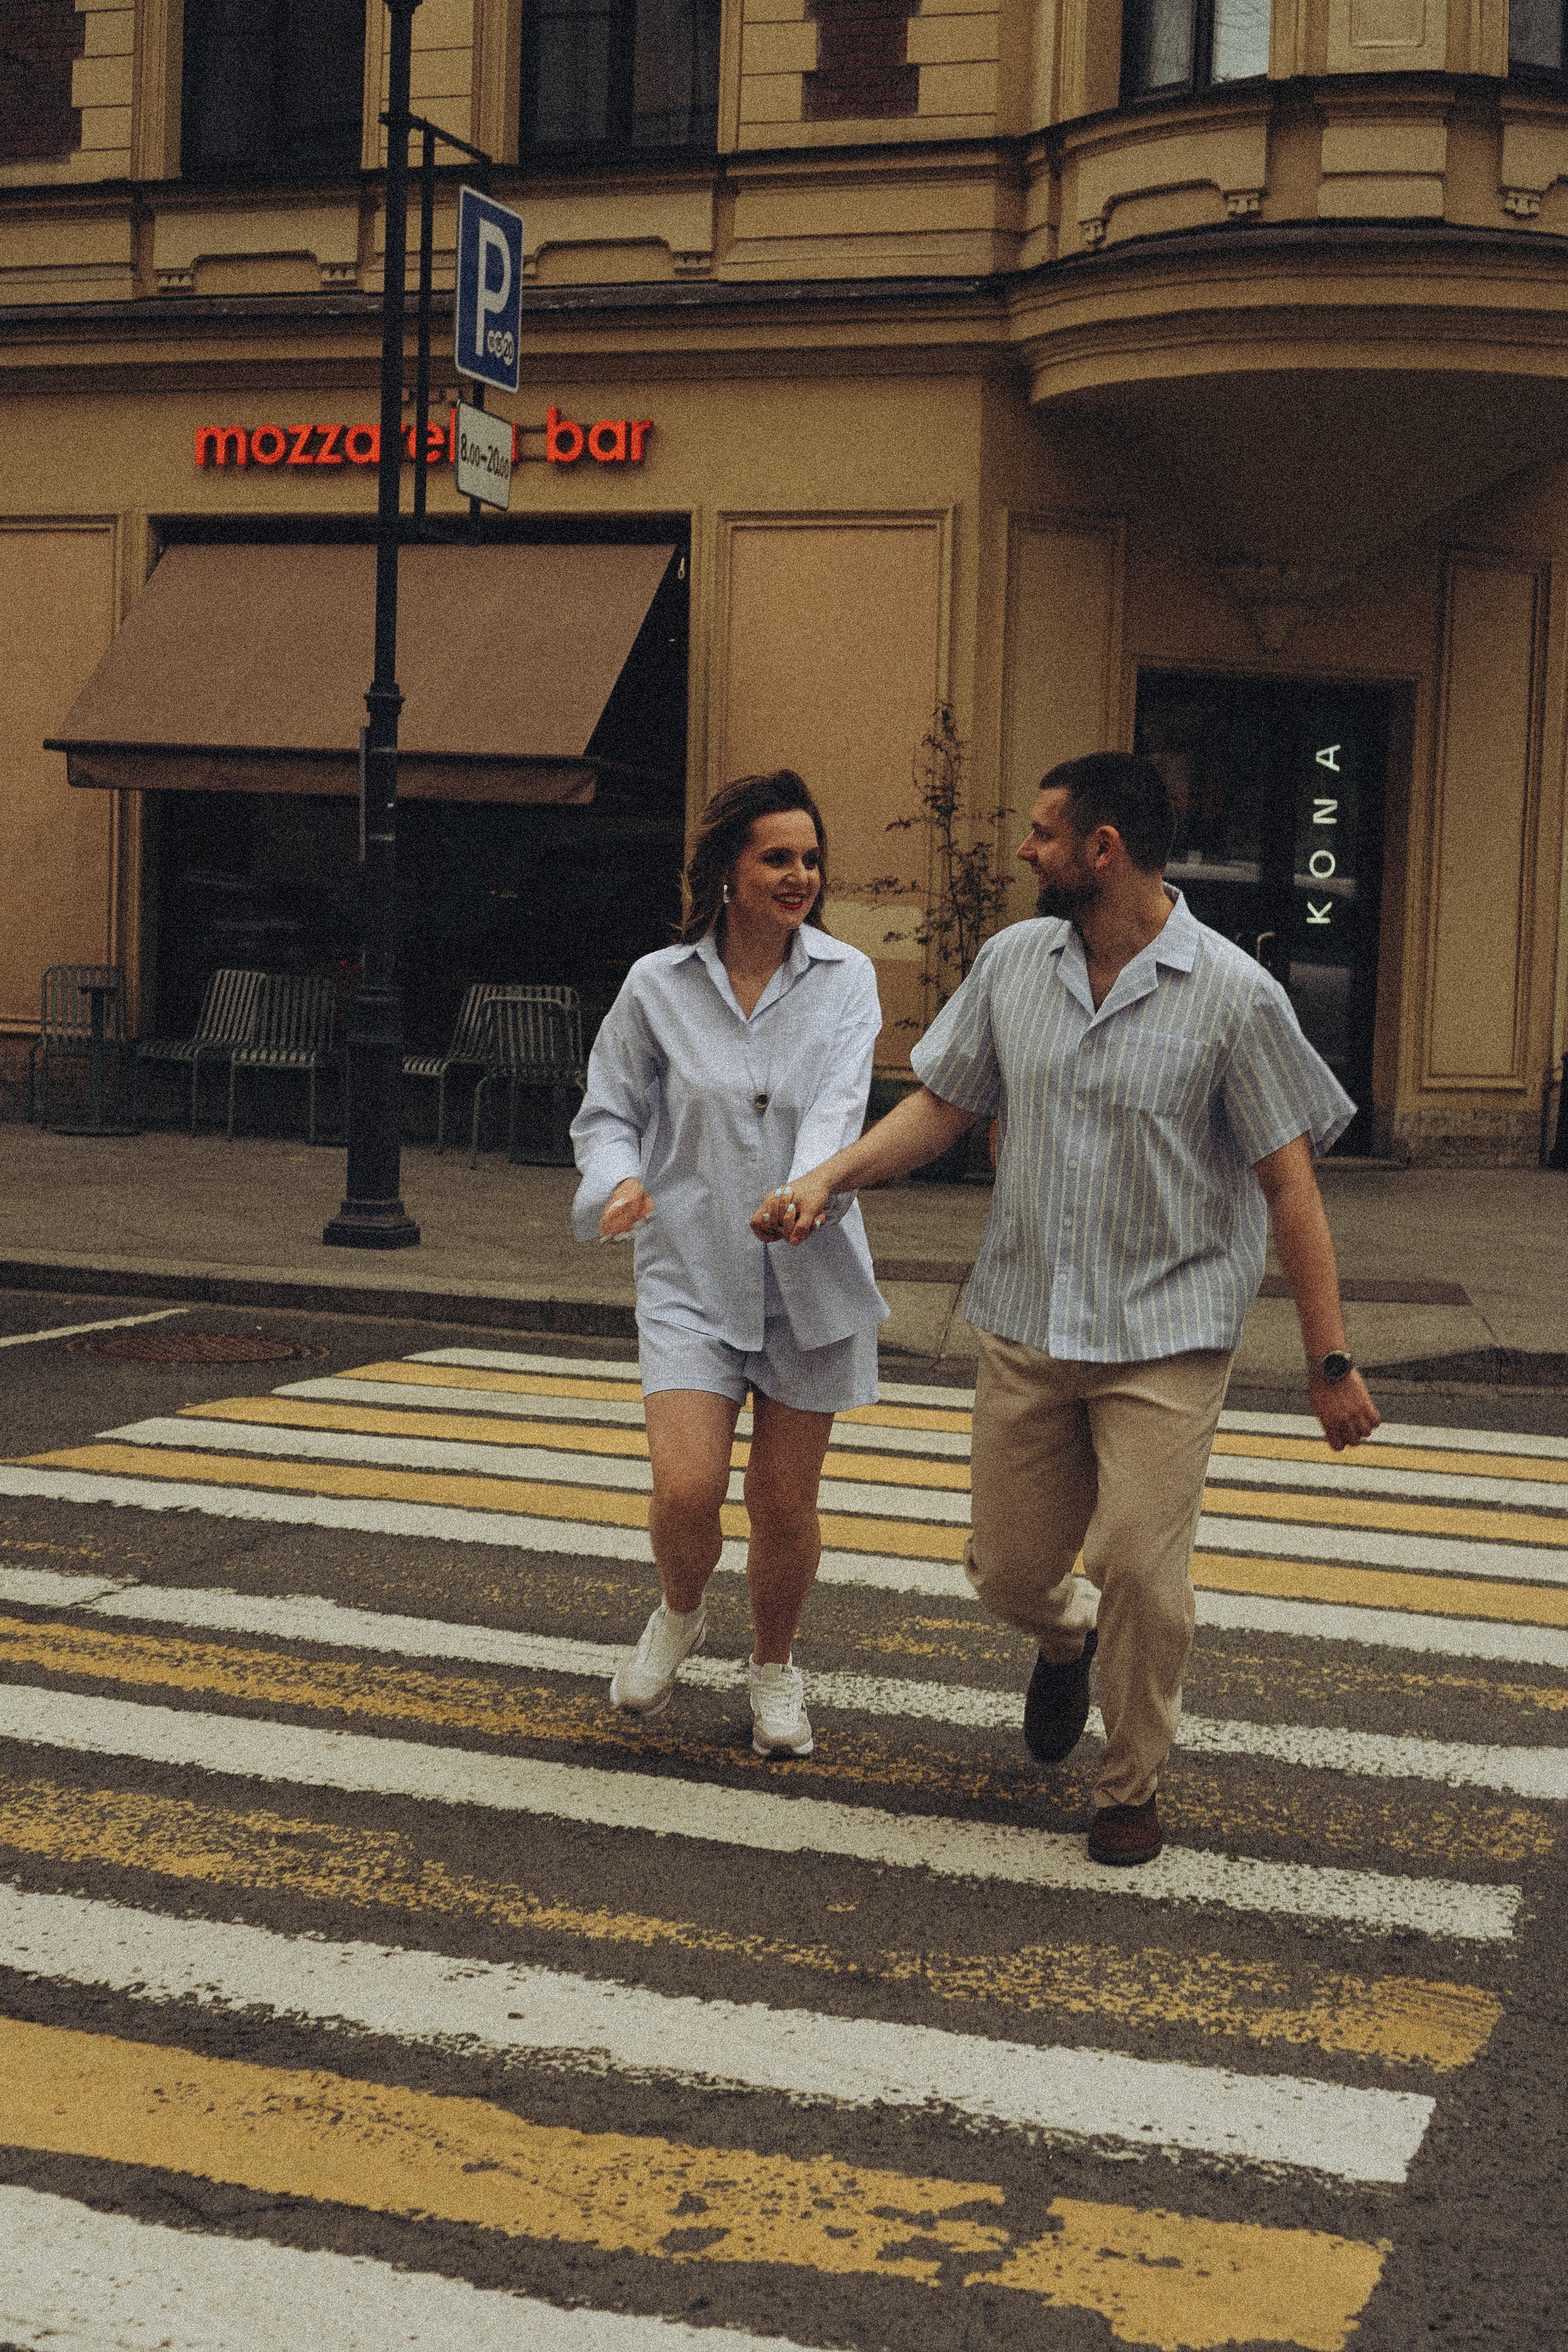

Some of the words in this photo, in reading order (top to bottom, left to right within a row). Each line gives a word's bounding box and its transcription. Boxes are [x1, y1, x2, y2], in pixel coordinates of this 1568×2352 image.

[475, 218, 511, 357] P
[546, 406, 653, 463] bar
[1306, 744, 1341, 924] KONA
